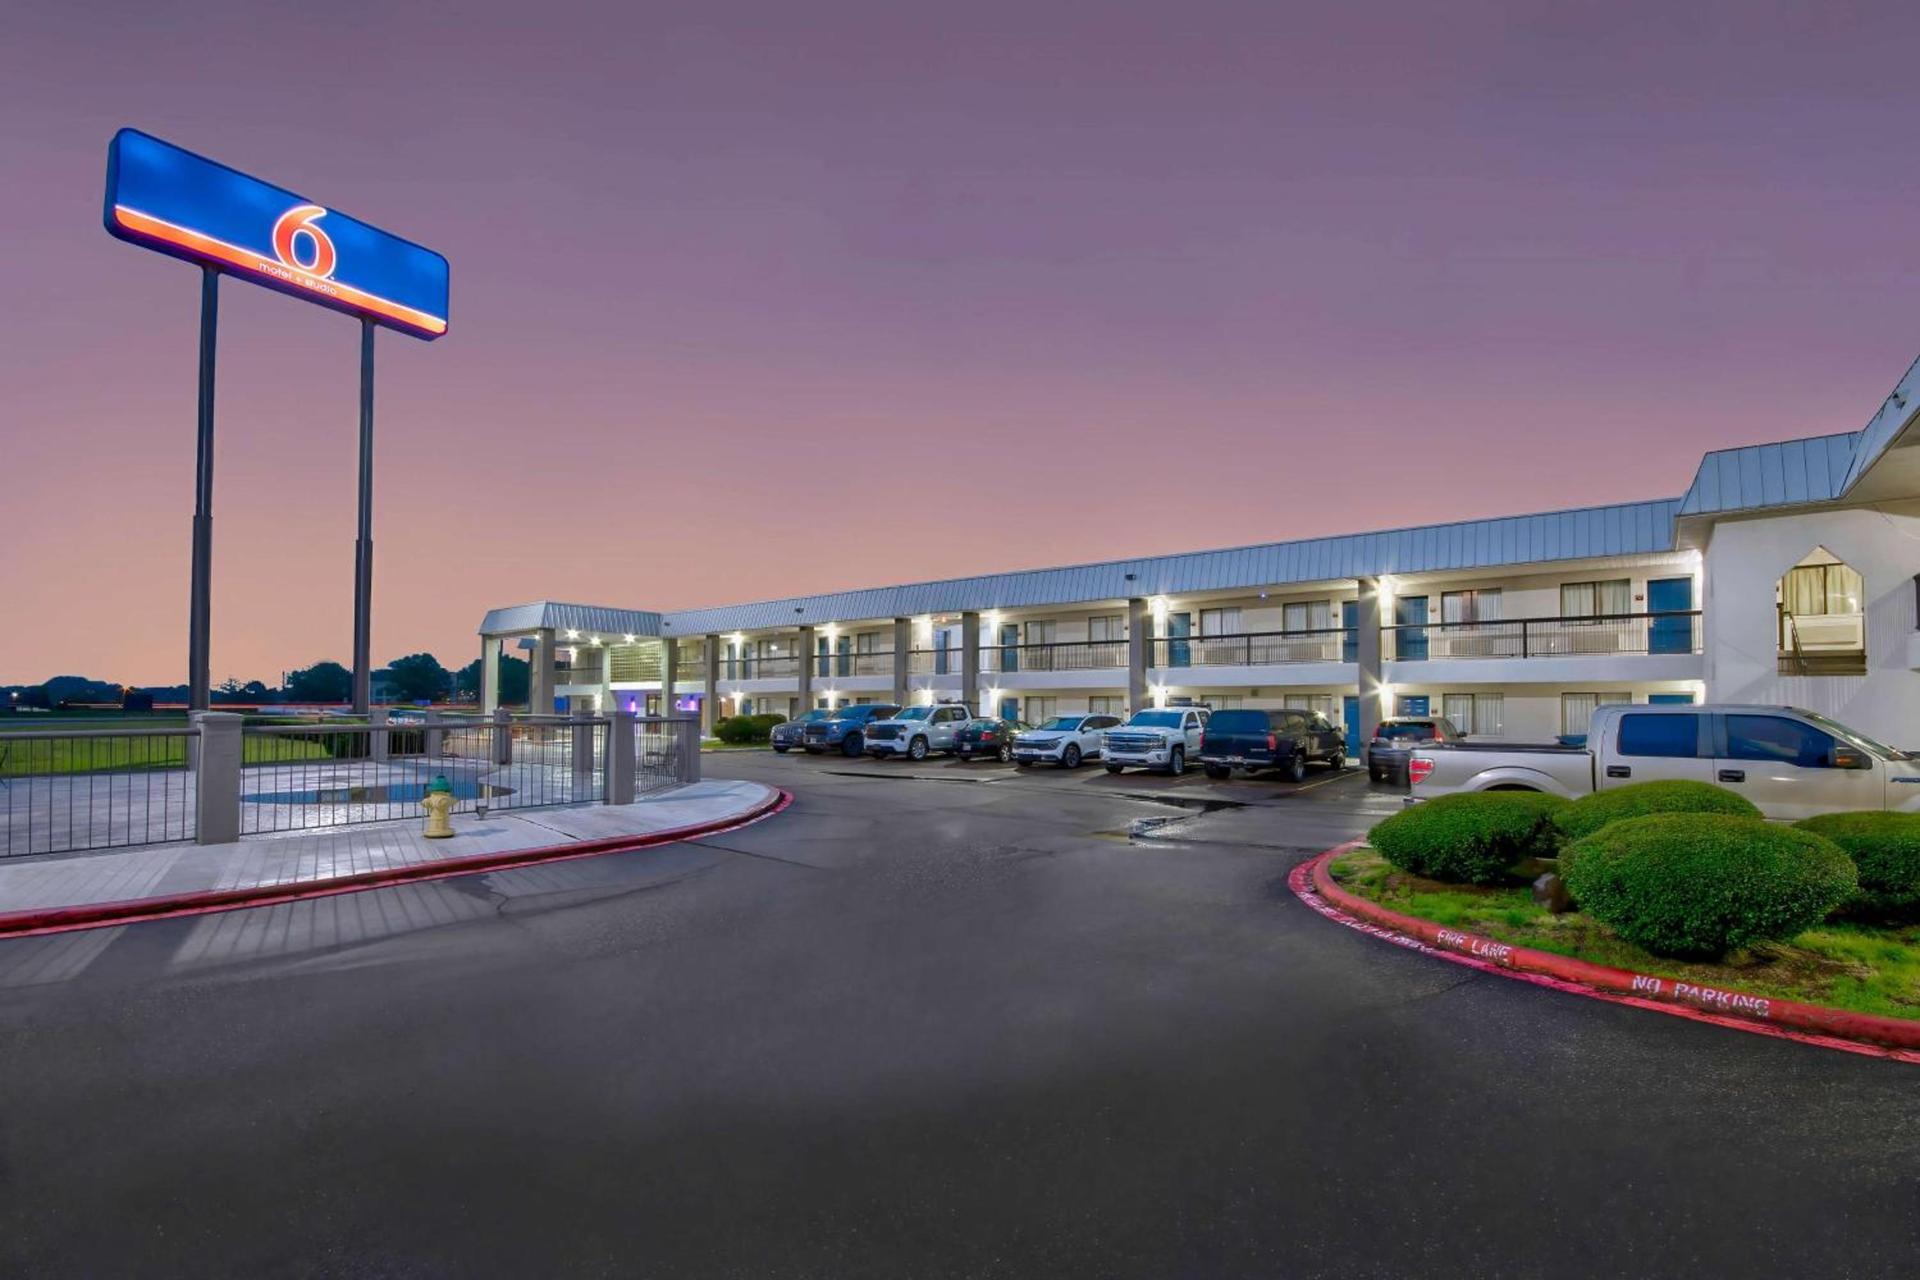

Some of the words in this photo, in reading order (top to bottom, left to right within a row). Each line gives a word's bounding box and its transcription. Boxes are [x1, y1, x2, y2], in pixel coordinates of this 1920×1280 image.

[272, 205, 336, 280] 6
[259, 263, 292, 279] motel
[304, 279, 337, 295] studio
[1471, 939, 1513, 962] LANE
[1632, 975, 1662, 993] NO
[1674, 983, 1770, 1016] PARKING
